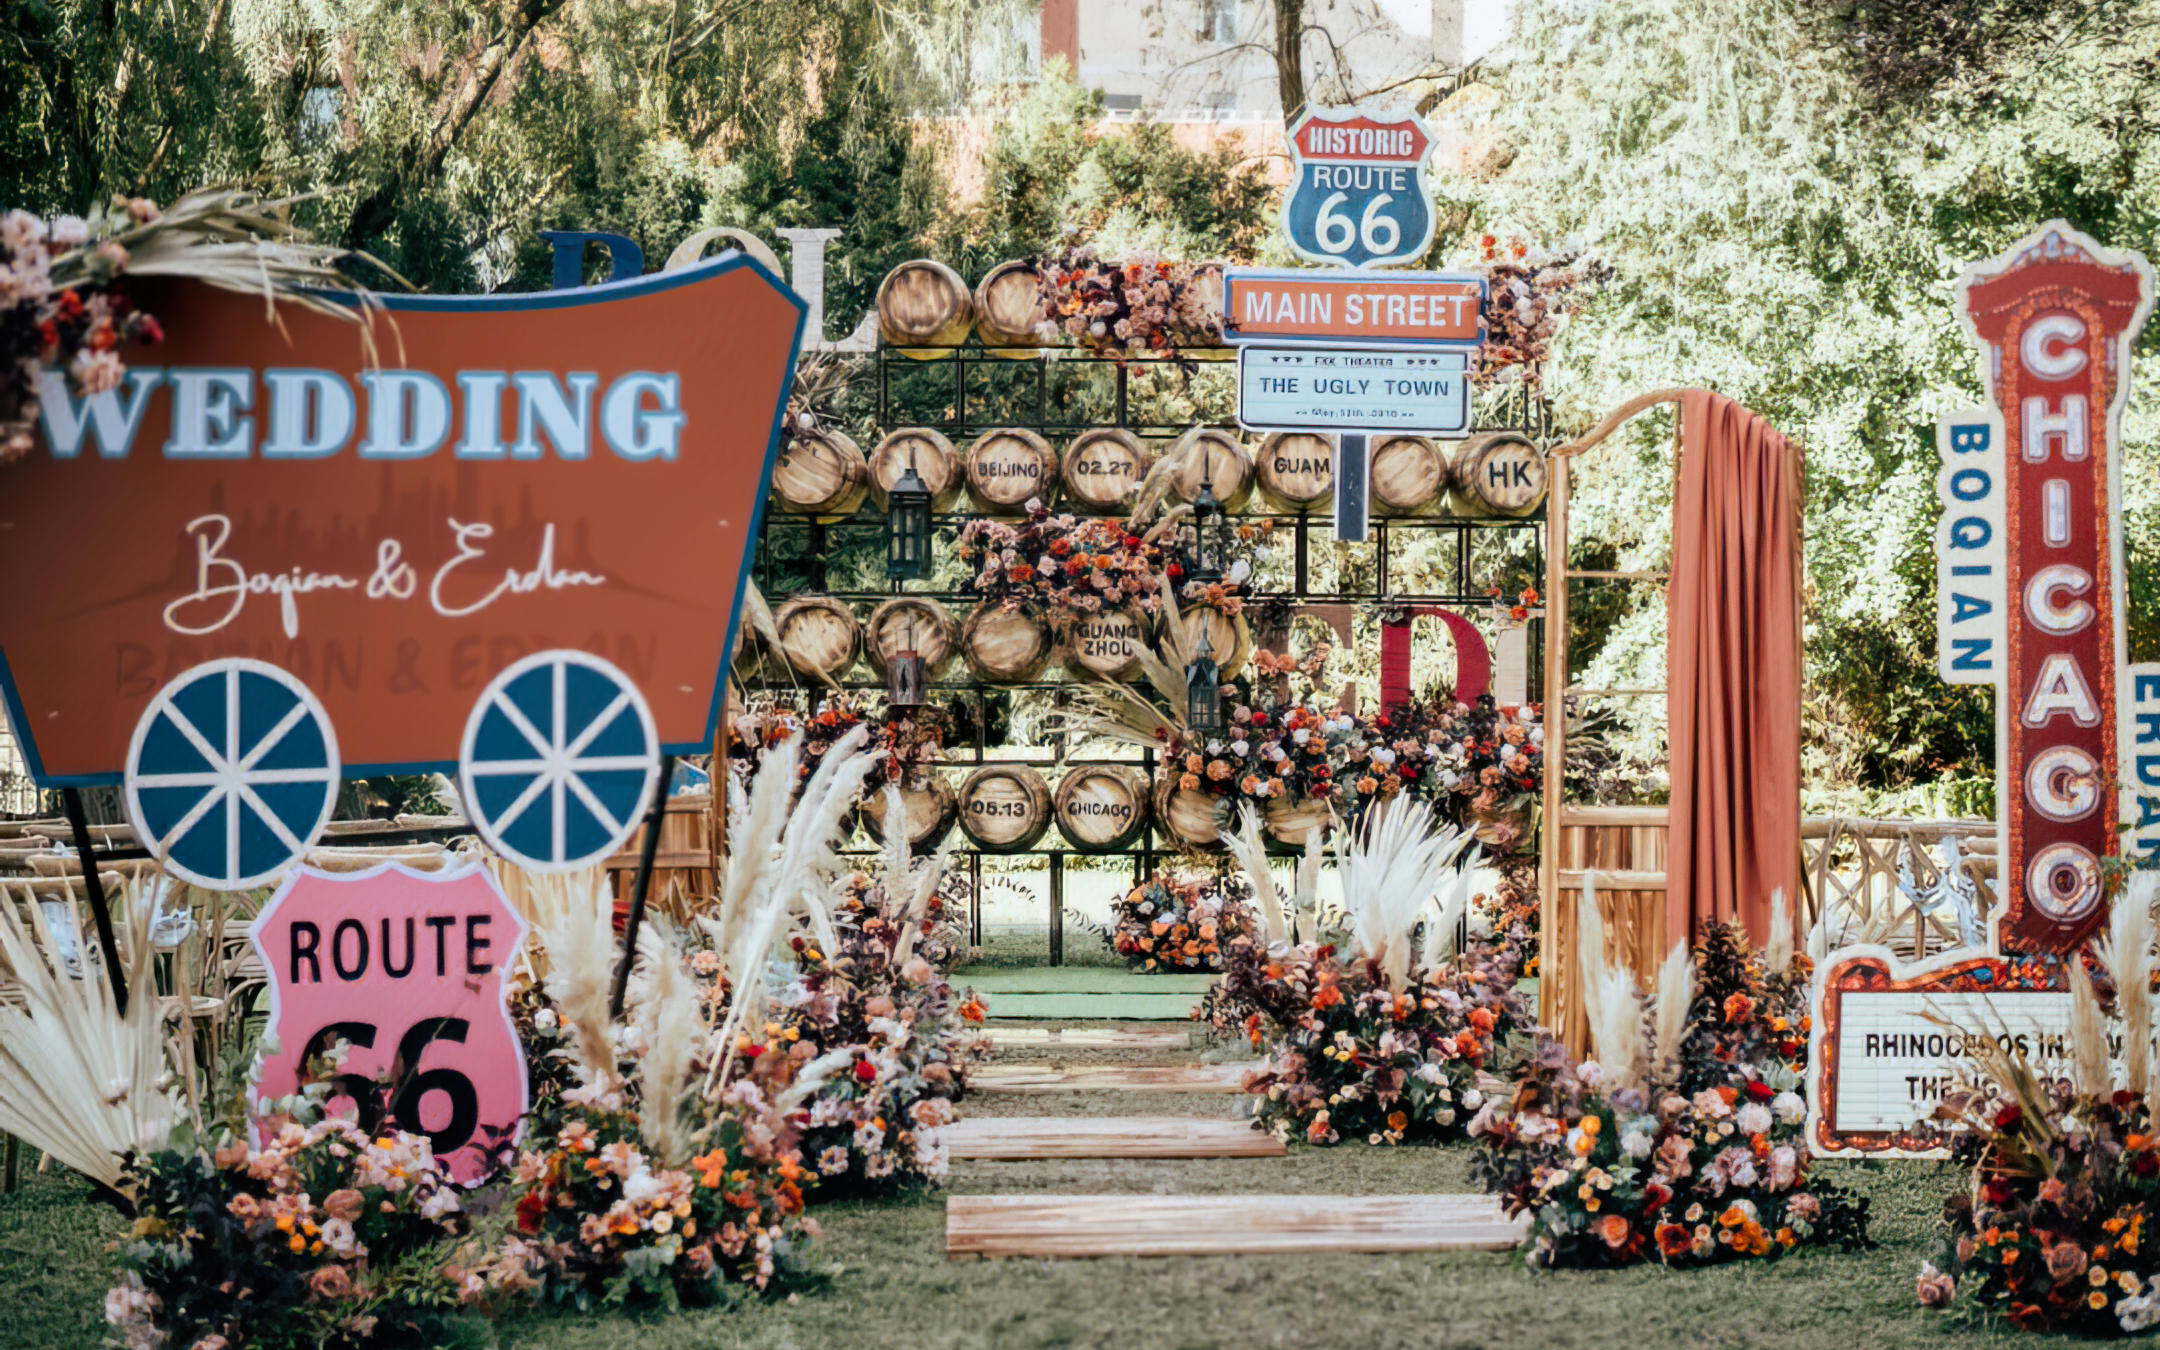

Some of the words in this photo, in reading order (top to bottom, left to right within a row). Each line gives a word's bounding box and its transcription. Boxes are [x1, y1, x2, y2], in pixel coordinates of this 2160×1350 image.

[1310, 126, 1414, 157] HISTORIC
[1313, 166, 1407, 191] ROUTE
[1315, 191, 1401, 256] 66
[1245, 291, 1332, 325] MAIN
[1345, 292, 1468, 328] STREET
[1259, 377, 1299, 394] THE
[1314, 378, 1370, 395] UGLY
[1384, 379, 1449, 397] TOWN
[36, 366, 687, 462] WEDDING
[977, 461, 1039, 479] BEIJING
[1076, 460, 1133, 476] 02.27
[1274, 456, 1331, 475] GUAM
[1488, 459, 1534, 489] HK
[1949, 421, 1994, 673] BOQIAN
[366, 538, 416, 599] &
[2019, 315, 2107, 924] CHICAGO
[1083, 640, 1134, 657] ZHOU
[972, 800, 1025, 818] 05.13
[1067, 801, 1132, 819] CHICAGO
[290, 914, 493, 984] ROUTE
